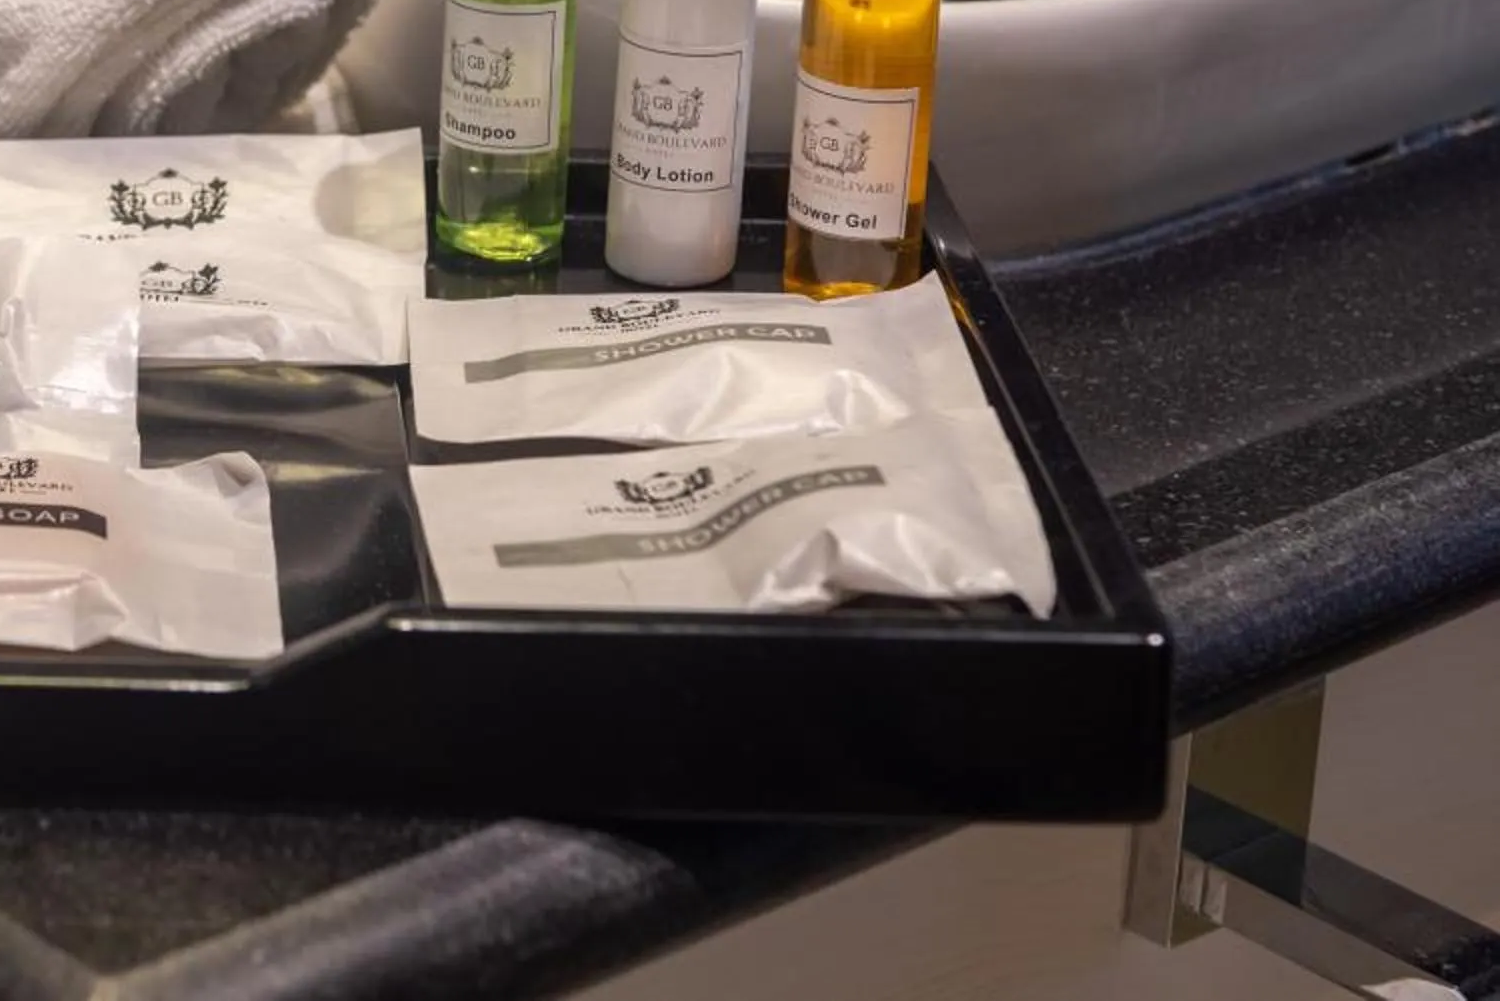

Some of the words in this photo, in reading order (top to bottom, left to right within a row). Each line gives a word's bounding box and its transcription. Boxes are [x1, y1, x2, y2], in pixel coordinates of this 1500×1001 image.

[466, 54, 486, 71] GB
[653, 96, 674, 112] GB
[819, 137, 840, 152] GB
[617, 152, 651, 181] Body
[656, 166, 714, 183] Lotion
[151, 191, 185, 207] GB
[846, 213, 878, 230] Gel
[595, 326, 737, 362] SHOWER
[746, 325, 816, 340] CAP
[637, 486, 783, 552] SHOWER
